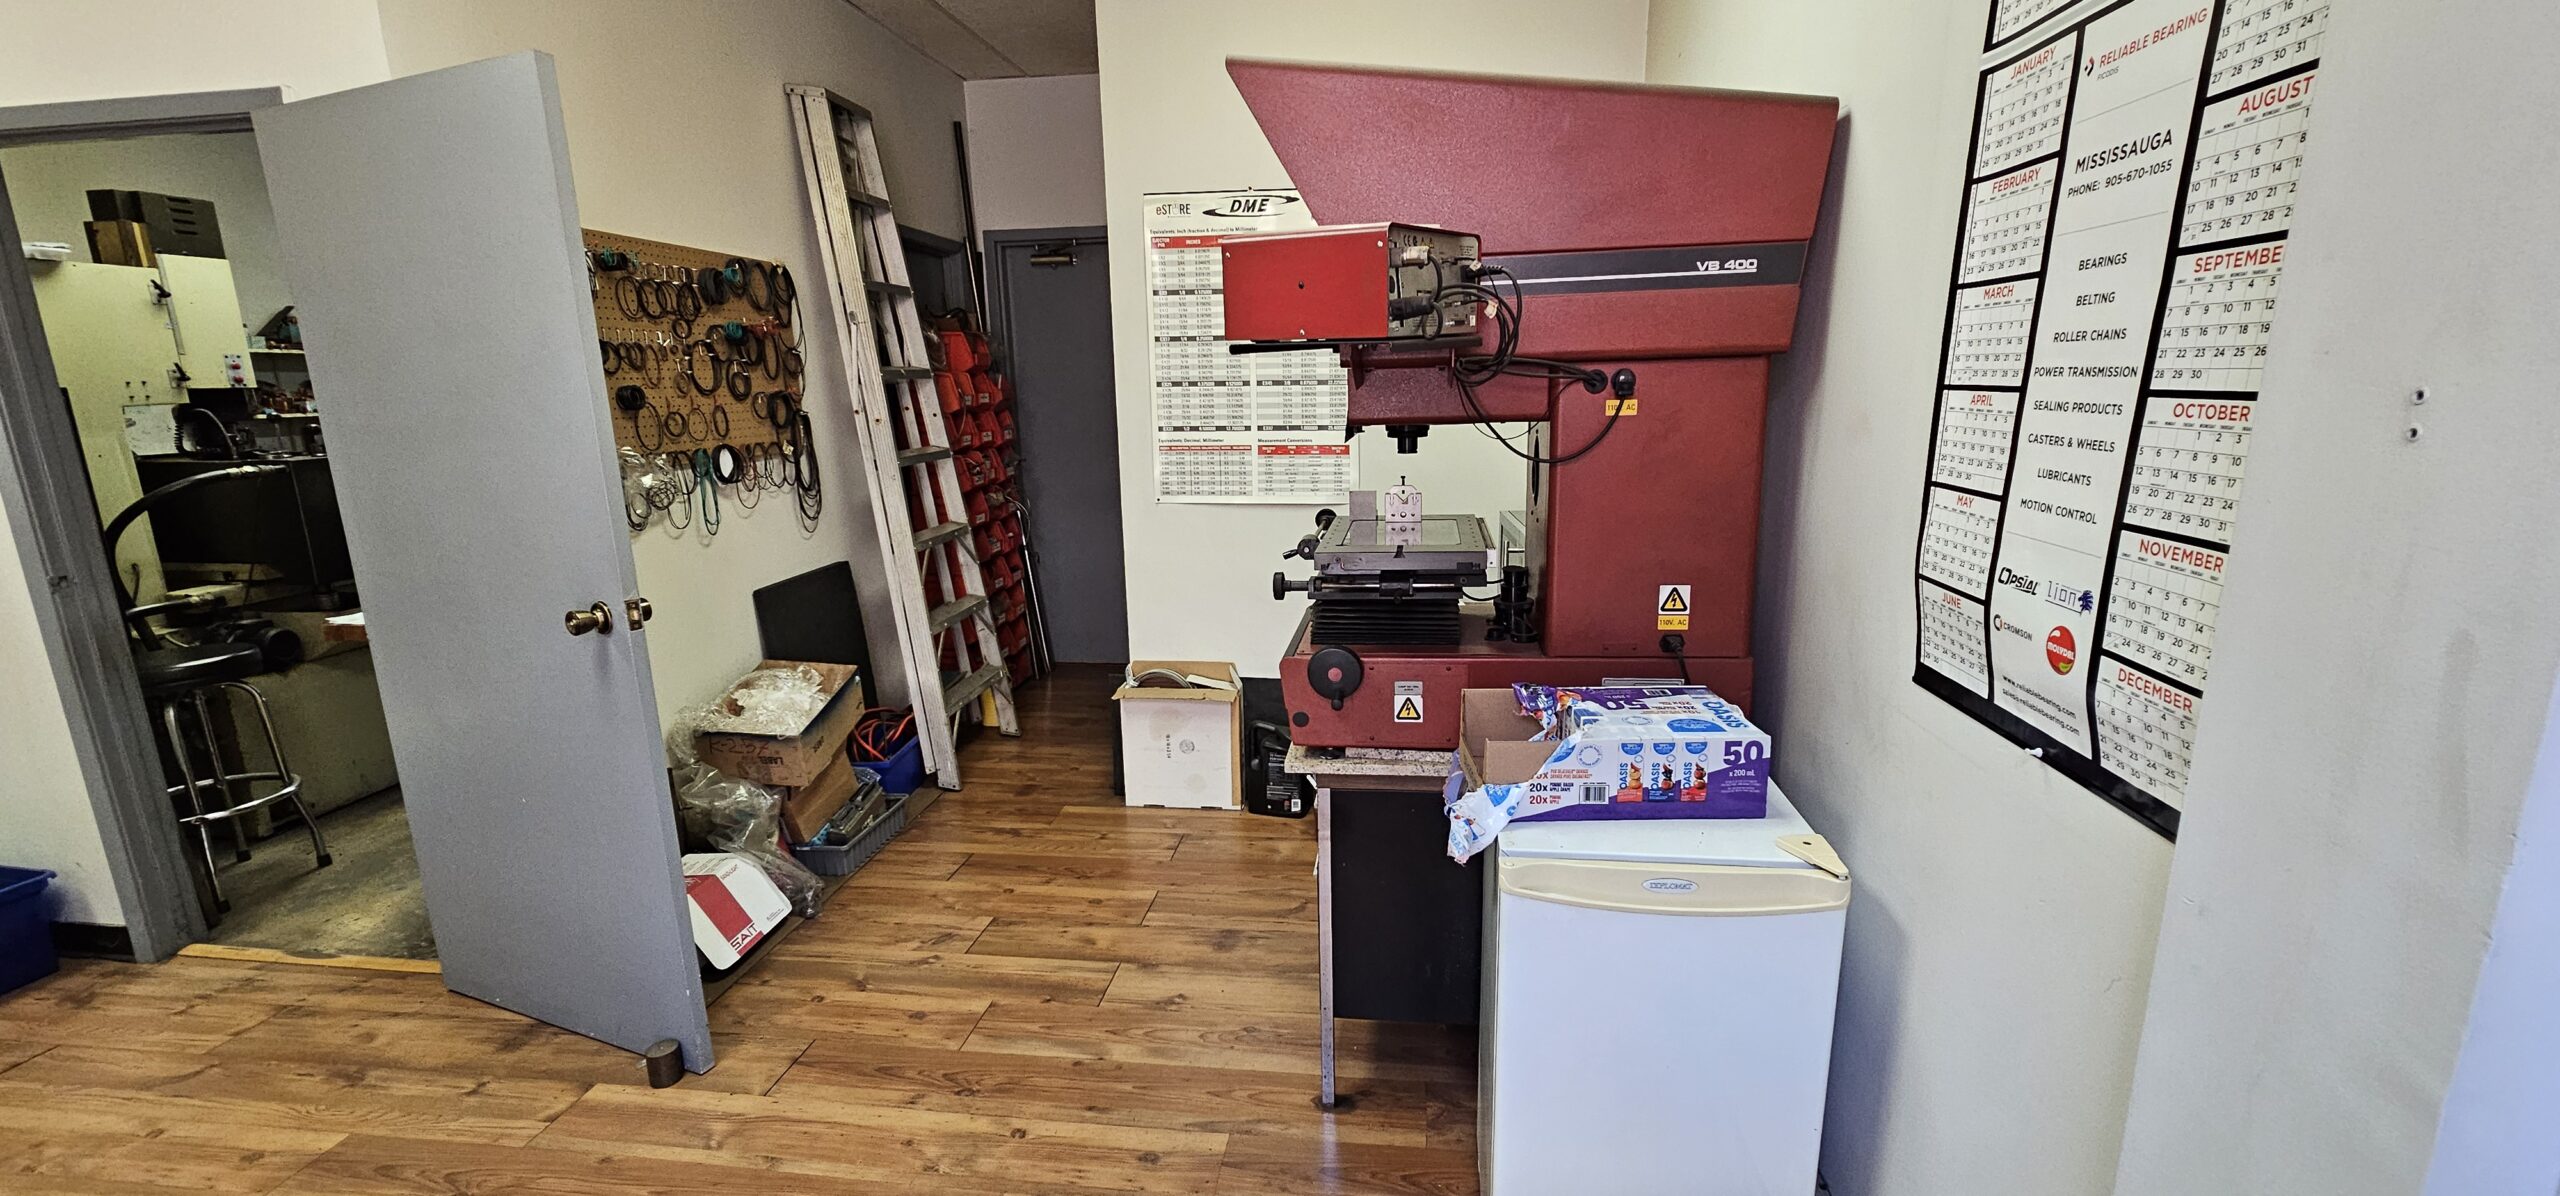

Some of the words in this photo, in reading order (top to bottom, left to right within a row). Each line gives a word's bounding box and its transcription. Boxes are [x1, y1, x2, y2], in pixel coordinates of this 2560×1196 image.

[2222, 27, 2230, 38] 13
[2242, 18, 2250, 29] 14
[2262, 9, 2271, 20] 15
[2284, 2, 2293, 11] 16
[2099, 34, 2150, 68] RELIABLE
[2152, 8, 2208, 45] BEARING
[2216, 49, 2228, 61] 20
[2235, 42, 2245, 53] 21
[2256, 33, 2268, 45] 22
[2278, 23, 2290, 36] 23
[2301, 14, 2313, 28] 24
[2010, 46, 2056, 80] JANUARY
[2212, 72, 2222, 84] 27
[2231, 65, 2242, 77] 28
[2252, 57, 2263, 69] 29
[2273, 48, 2286, 61] 30
[2296, 40, 2306, 53] 31
[2238, 75, 2315, 116] AUGUST
[2075, 129, 2172, 174] MISSISSAUGA
[1992, 167, 2041, 193] FEBRUARY
[2067, 180, 2100, 198] PHONE:
[2104, 159, 2173, 188] 905-670-1055
[1229, 198, 1270, 213] DME
[1696, 260, 1720, 271] VB
[1724, 259, 1758, 270] 400
[2078, 253, 2128, 271] BEARINGS
[2194, 245, 2283, 273] SEPTEMBE
[1983, 285, 2014, 300] MARCH
[2190, 286, 2194, 294] 1
[2208, 284, 2213, 292] 2
[2228, 282, 2233, 290] 3
[2248, 279, 2254, 288] 4
[2270, 276, 2276, 286] 5
[2076, 292, 2115, 306] BELTING
[2167, 309, 2172, 317] 7
[2185, 307, 2190, 316] 8
[2204, 306, 2209, 314] 9
[2224, 304, 2233, 312] 10
[2244, 302, 2251, 311] 11
[2265, 300, 2275, 310] 12
[2053, 331, 2087, 342] ROLLER
[2090, 328, 2127, 341] CHAINS
[2163, 329, 2171, 338] 14
[2181, 328, 2189, 336] 15
[2200, 327, 2208, 336] 16
[2218, 326, 2227, 335] 17
[2239, 325, 2248, 334] 18
[2260, 324, 2270, 333] 19
[2159, 350, 2167, 358] 21
[2176, 350, 2186, 358] 22
[2195, 349, 2205, 357] 23
[2214, 348, 2225, 357] 24
[2234, 348, 2245, 356] 25
[2255, 346, 2267, 356] 26
[2034, 367, 2064, 377] POWER
[2068, 366, 2138, 377] TRANSMISSION
[2154, 370, 2164, 378] 28
[2172, 370, 2183, 378] 29
[2191, 370, 2202, 378] 30
[1970, 394, 1993, 407] APRIL
[2034, 400, 2069, 412] SEALING
[2072, 402, 2123, 415] PRODUCTS
[2173, 403, 2250, 421] OCTOBER
[2028, 433, 2065, 446] CASTERS
[2067, 437, 2073, 447] &
[2077, 438, 2115, 452] WHEELS
[2197, 432, 2201, 440] 1
[2216, 433, 2221, 442] 2
[2236, 435, 2242, 444] 3
[2139, 447, 2144, 455] 5
[2156, 449, 2161, 457] 6
[2192, 453, 2198, 461] 8
[2212, 455, 2217, 463] 9
[2232, 457, 2241, 466] 10
[2037, 467, 2091, 486] LUBRICANTS
[2136, 467, 2143, 475] 12
[2152, 469, 2160, 477] 13
[2170, 471, 2178, 479] 14
[2189, 474, 2197, 482] 15
[2208, 476, 2216, 485] 16
[2227, 479, 2236, 488] 17
[1956, 495, 1974, 508] MAY
[2132, 486, 2139, 494] 19
[2148, 489, 2158, 497] 20
[2166, 492, 2174, 500] 21
[2184, 495, 2195, 503] 22
[2203, 497, 2214, 506] 23
[2222, 501, 2233, 510] 24
[2020, 498, 2053, 514] MOTION
[2055, 506, 2097, 524] CONTROL
[2128, 505, 2137, 513] 26
[2144, 508, 2154, 516] 27
[2162, 512, 2172, 520] 28
[2180, 515, 2191, 524] 29
[2199, 519, 2210, 528] 30
[2218, 522, 2226, 531] 31
[2139, 539, 2224, 573] NOVEMBER
[1942, 592, 1961, 609] JUNE
[2003, 622, 2033, 641] CROMSON
[2118, 668, 2193, 713] DECEMBER
[1702, 701, 1749, 728] OASIS
[1723, 740, 1764, 766] 50
[1619, 762, 1628, 789] OASIS
[1651, 762, 1660, 790] OASIS
[1682, 762, 1692, 790] OASIS
[1529, 783, 1548, 792] 20x
[1529, 795, 1548, 804] 20x
[730, 923, 757, 950] SAIT
